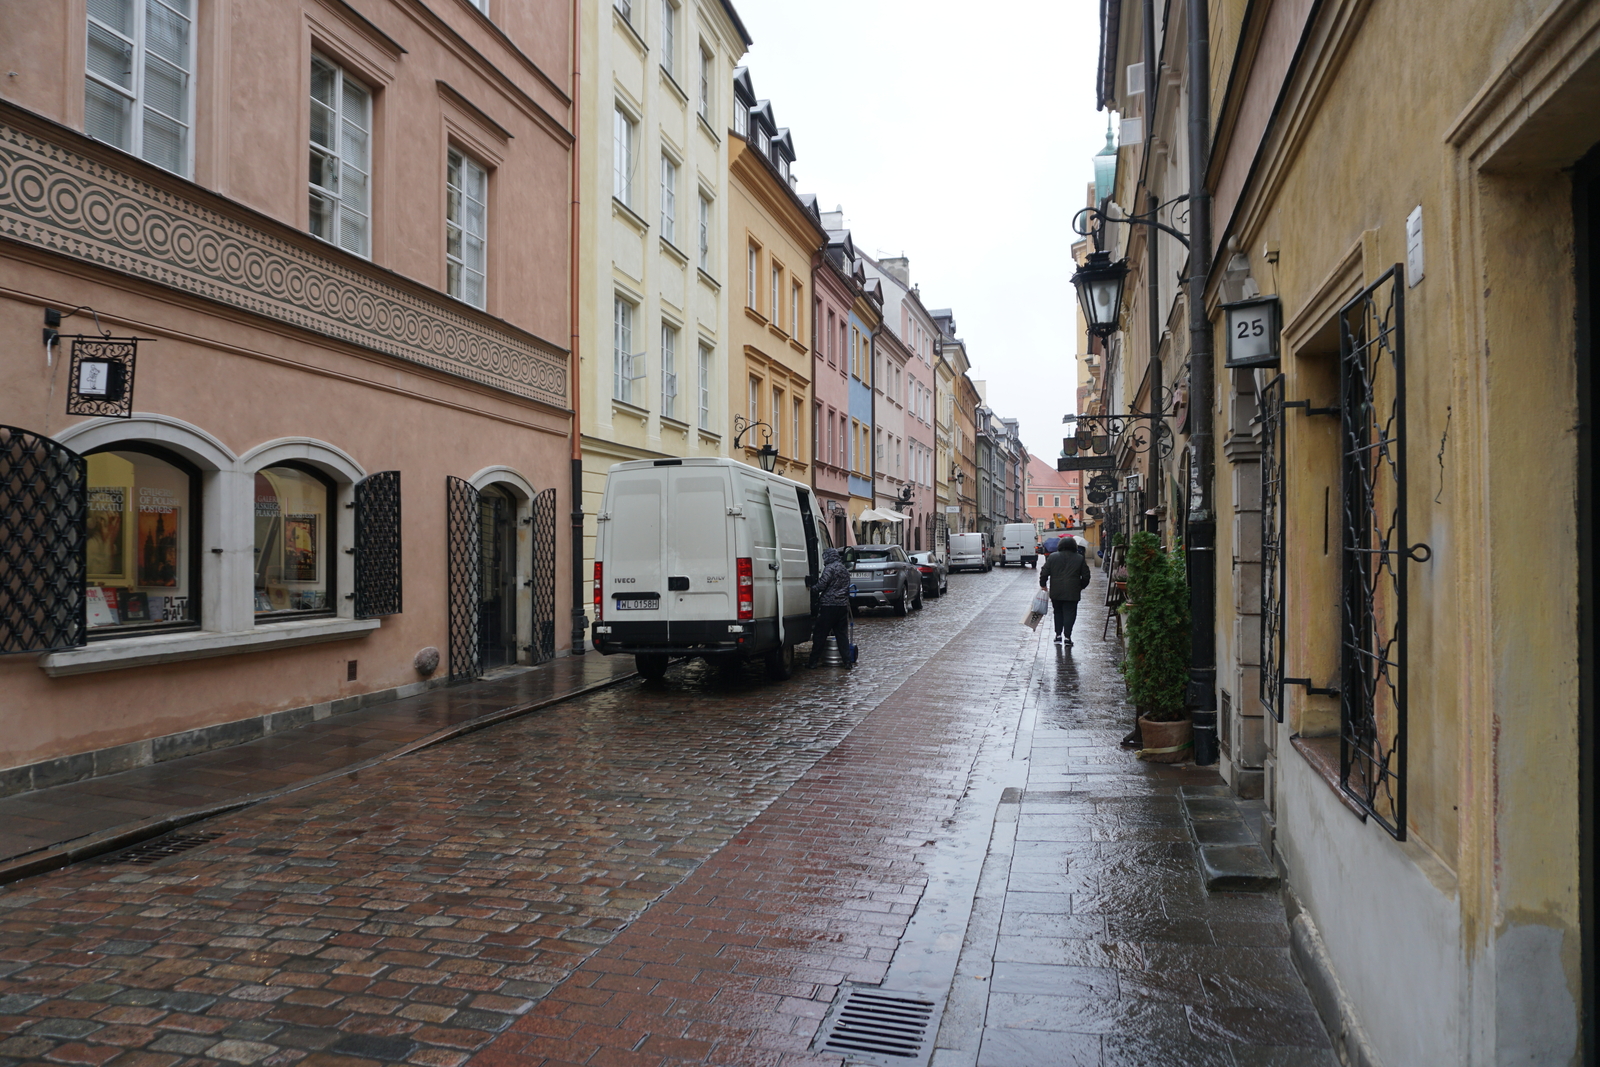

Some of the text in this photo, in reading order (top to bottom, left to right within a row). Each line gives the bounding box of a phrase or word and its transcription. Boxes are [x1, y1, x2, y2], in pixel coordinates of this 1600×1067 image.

[1237, 318, 1265, 339] 25
[140, 487, 173, 497] GALLERY
[87, 493, 124, 503] LSKIEGO
[140, 496, 179, 505] OF POLISH
[140, 505, 173, 514] POSTERS
[621, 600, 632, 609] WL
